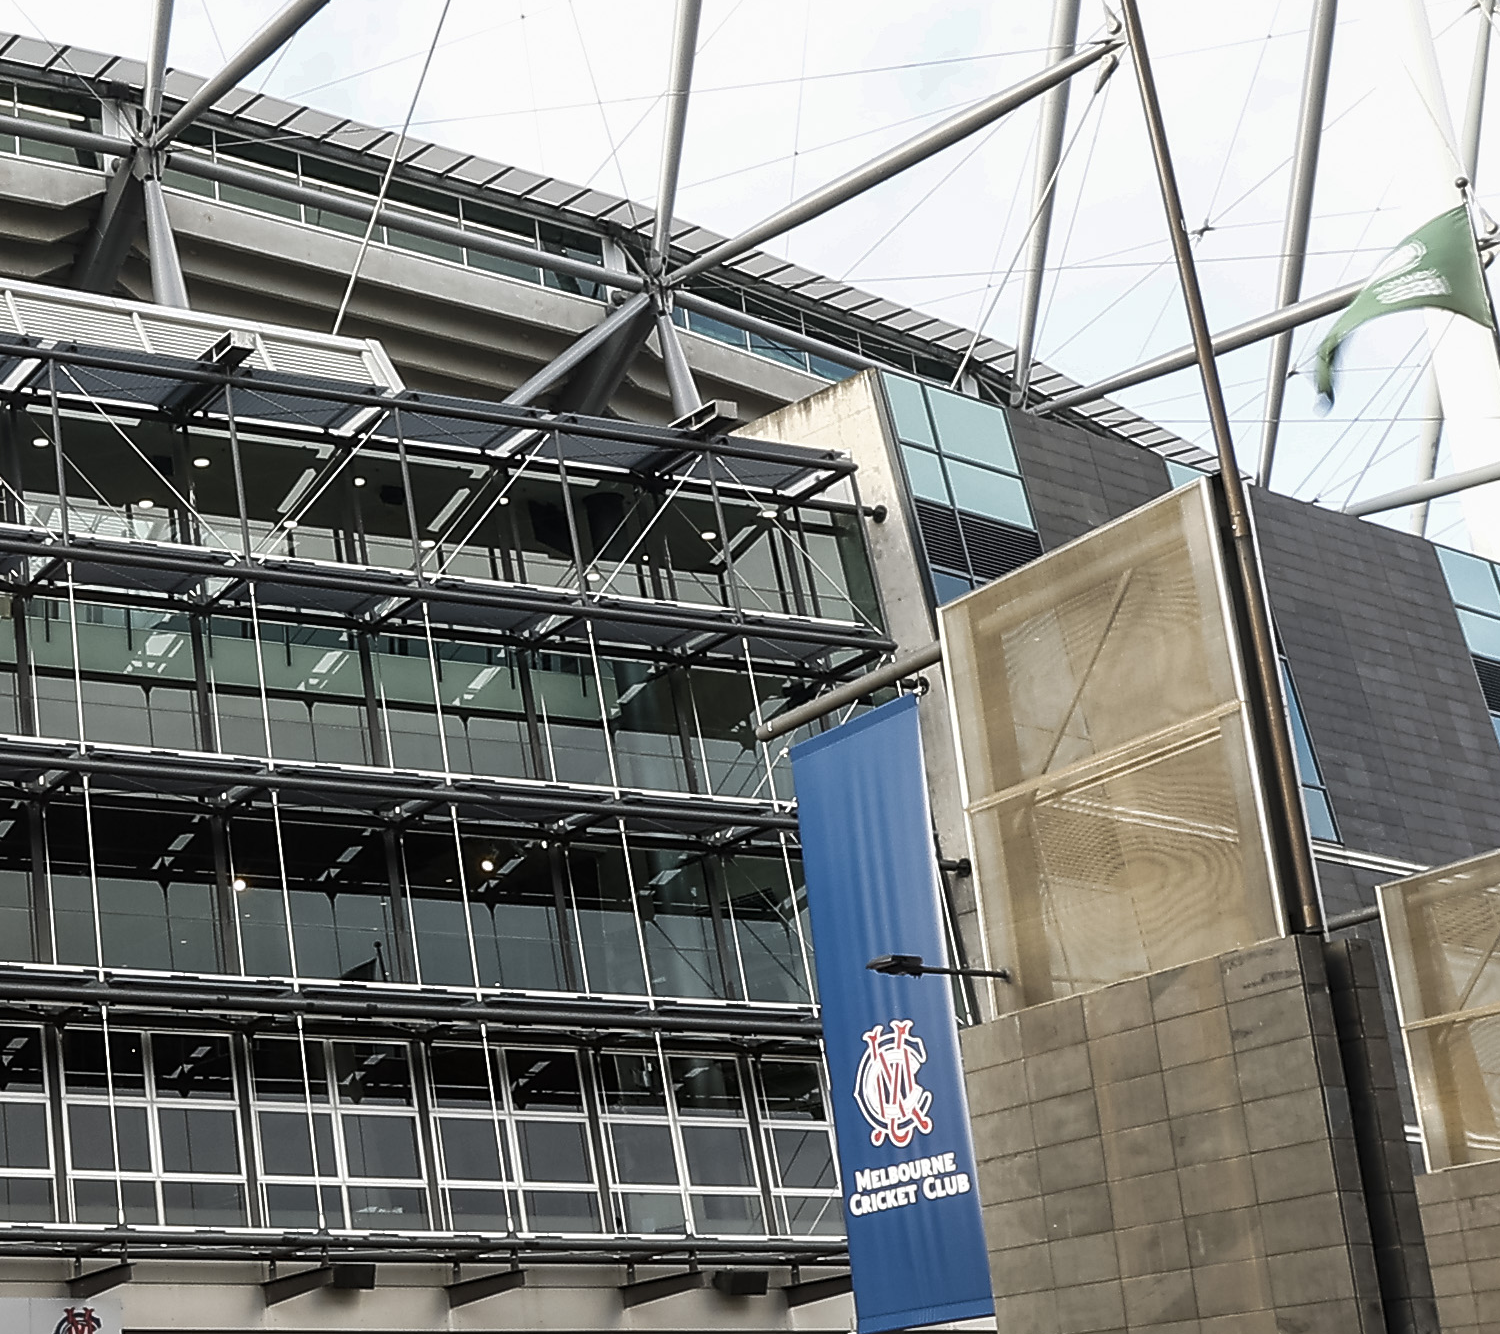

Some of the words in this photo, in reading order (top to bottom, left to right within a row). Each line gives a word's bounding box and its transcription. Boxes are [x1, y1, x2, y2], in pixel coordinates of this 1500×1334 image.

[855, 1152, 957, 1192] MELBOURNE
[849, 1183, 918, 1217] CRICKET
[922, 1173, 971, 1200] CLUB
